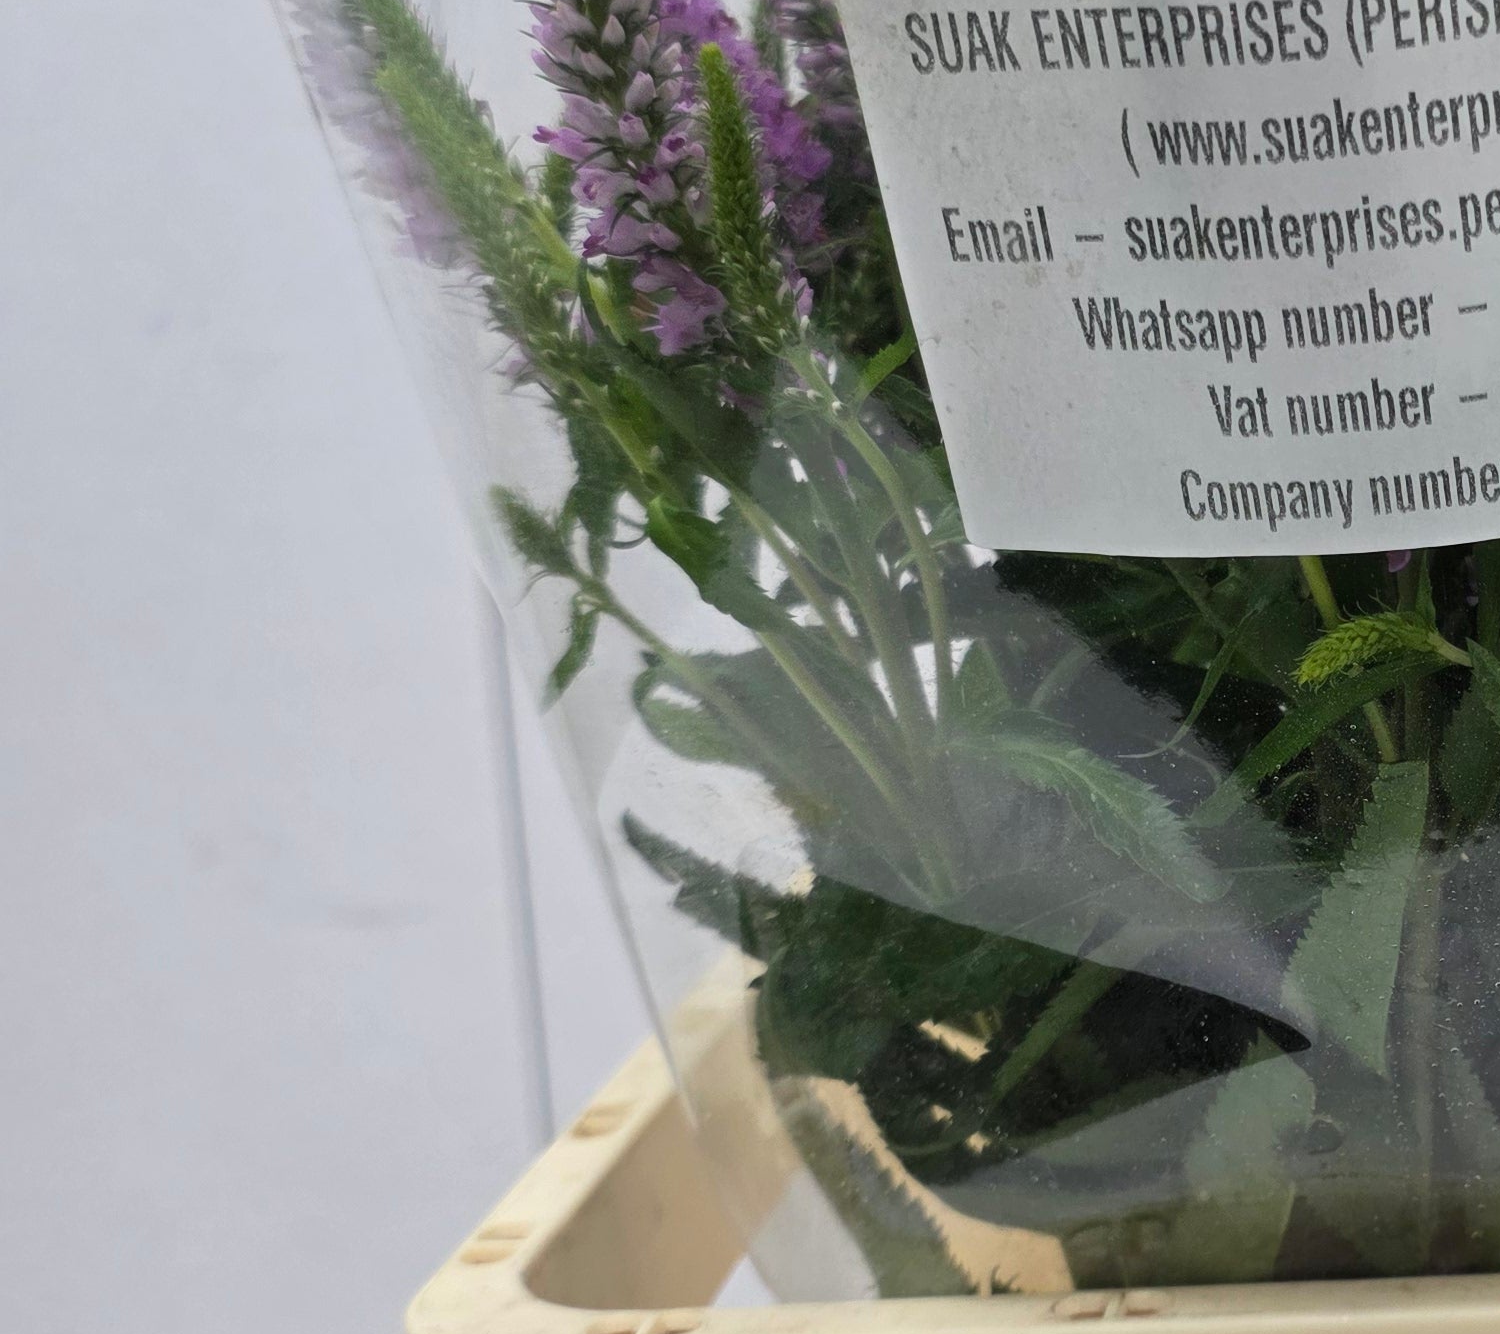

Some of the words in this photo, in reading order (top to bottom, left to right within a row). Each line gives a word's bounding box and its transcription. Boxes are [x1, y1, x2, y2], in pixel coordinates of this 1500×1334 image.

[904, 10, 1021, 76] SUAK
[941, 205, 1054, 265] Email
[1071, 296, 1267, 364] Whatsapp
[1281, 287, 1434, 349] number
[1206, 383, 1274, 438] Vat
[1285, 376, 1435, 437] number
[1179, 468, 1354, 533] Company
